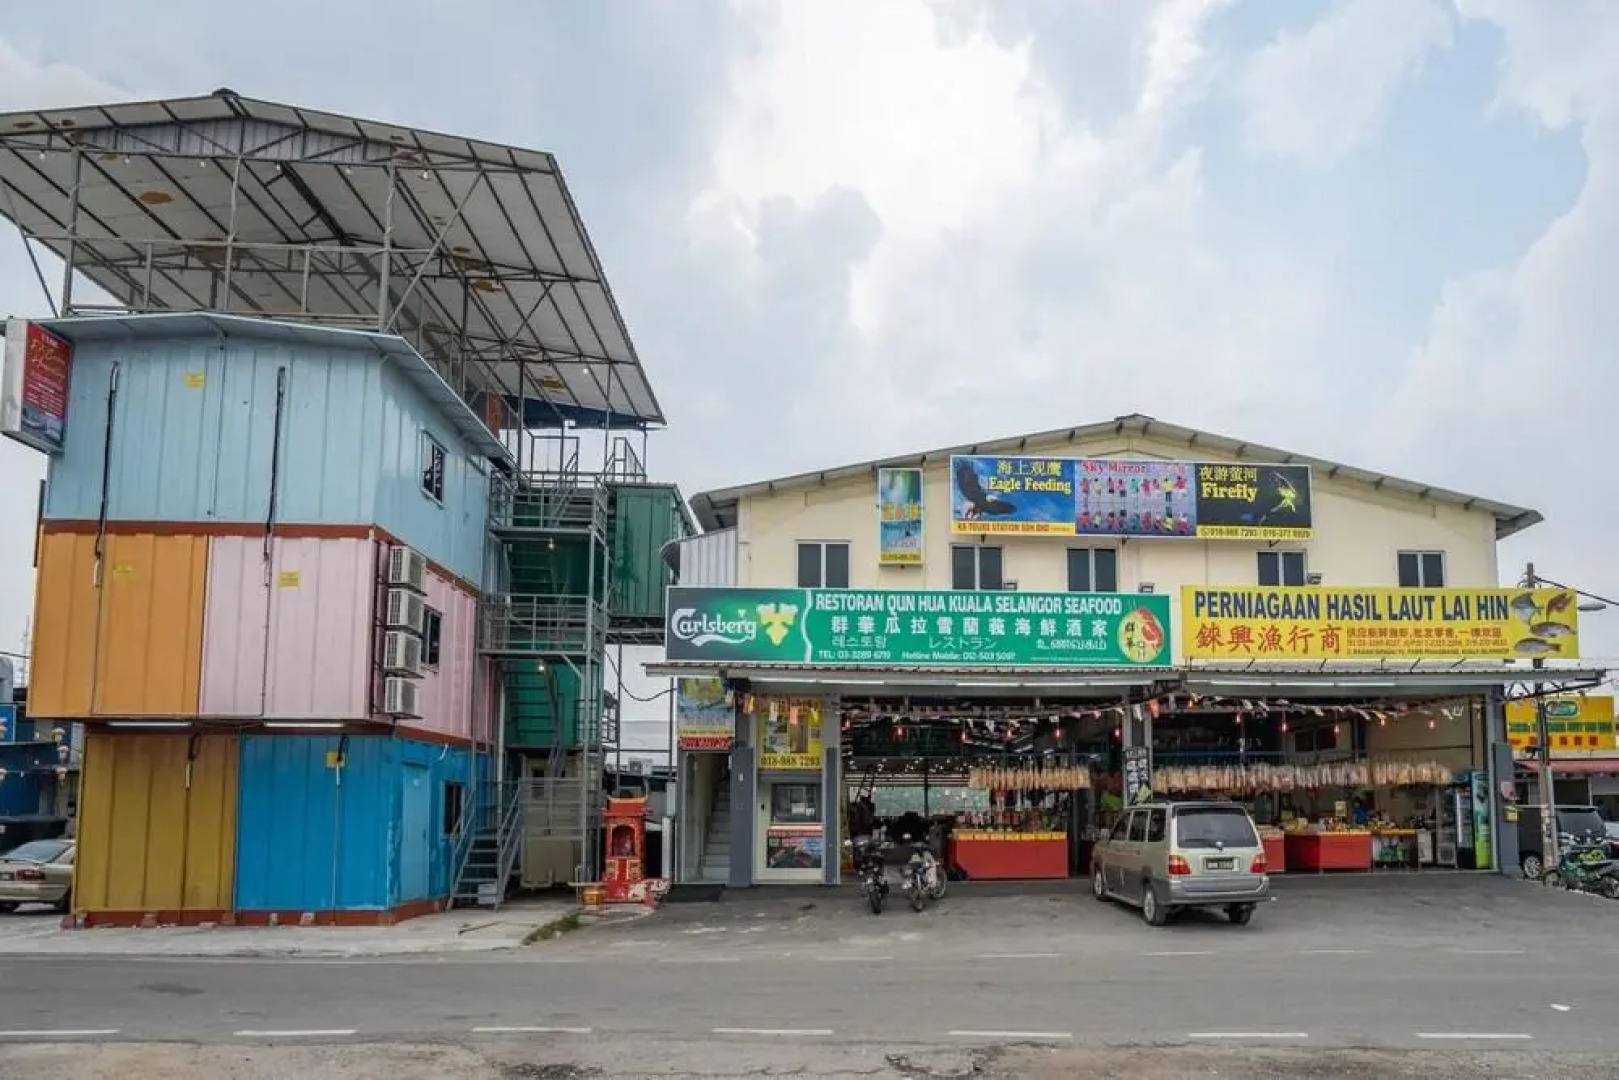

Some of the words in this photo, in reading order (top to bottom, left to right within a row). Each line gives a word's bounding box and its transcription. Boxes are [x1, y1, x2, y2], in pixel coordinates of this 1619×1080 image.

[1108, 460, 1147, 473] Mirror
[989, 478, 1022, 493] Eagle
[1025, 478, 1072, 494] Feeding
[1201, 482, 1258, 502] Firefly
[816, 594, 886, 611] RESTORAN
[887, 594, 915, 614] QUN
[918, 595, 946, 612] HUA
[949, 596, 992, 613] KUALA
[995, 596, 1062, 614] SELANGOR
[1064, 598, 1122, 614] SEAFOOD
[1194, 591, 1320, 620] PERNIAGAAN
[1326, 593, 1382, 620] HASIL
[1388, 595, 1435, 620] LAUT
[1441, 596, 1471, 620] LAI
[1477, 596, 1510, 621] HIN
[671, 608, 757, 646] Carlsberg
[929, 636, 997, 649] レストラン
